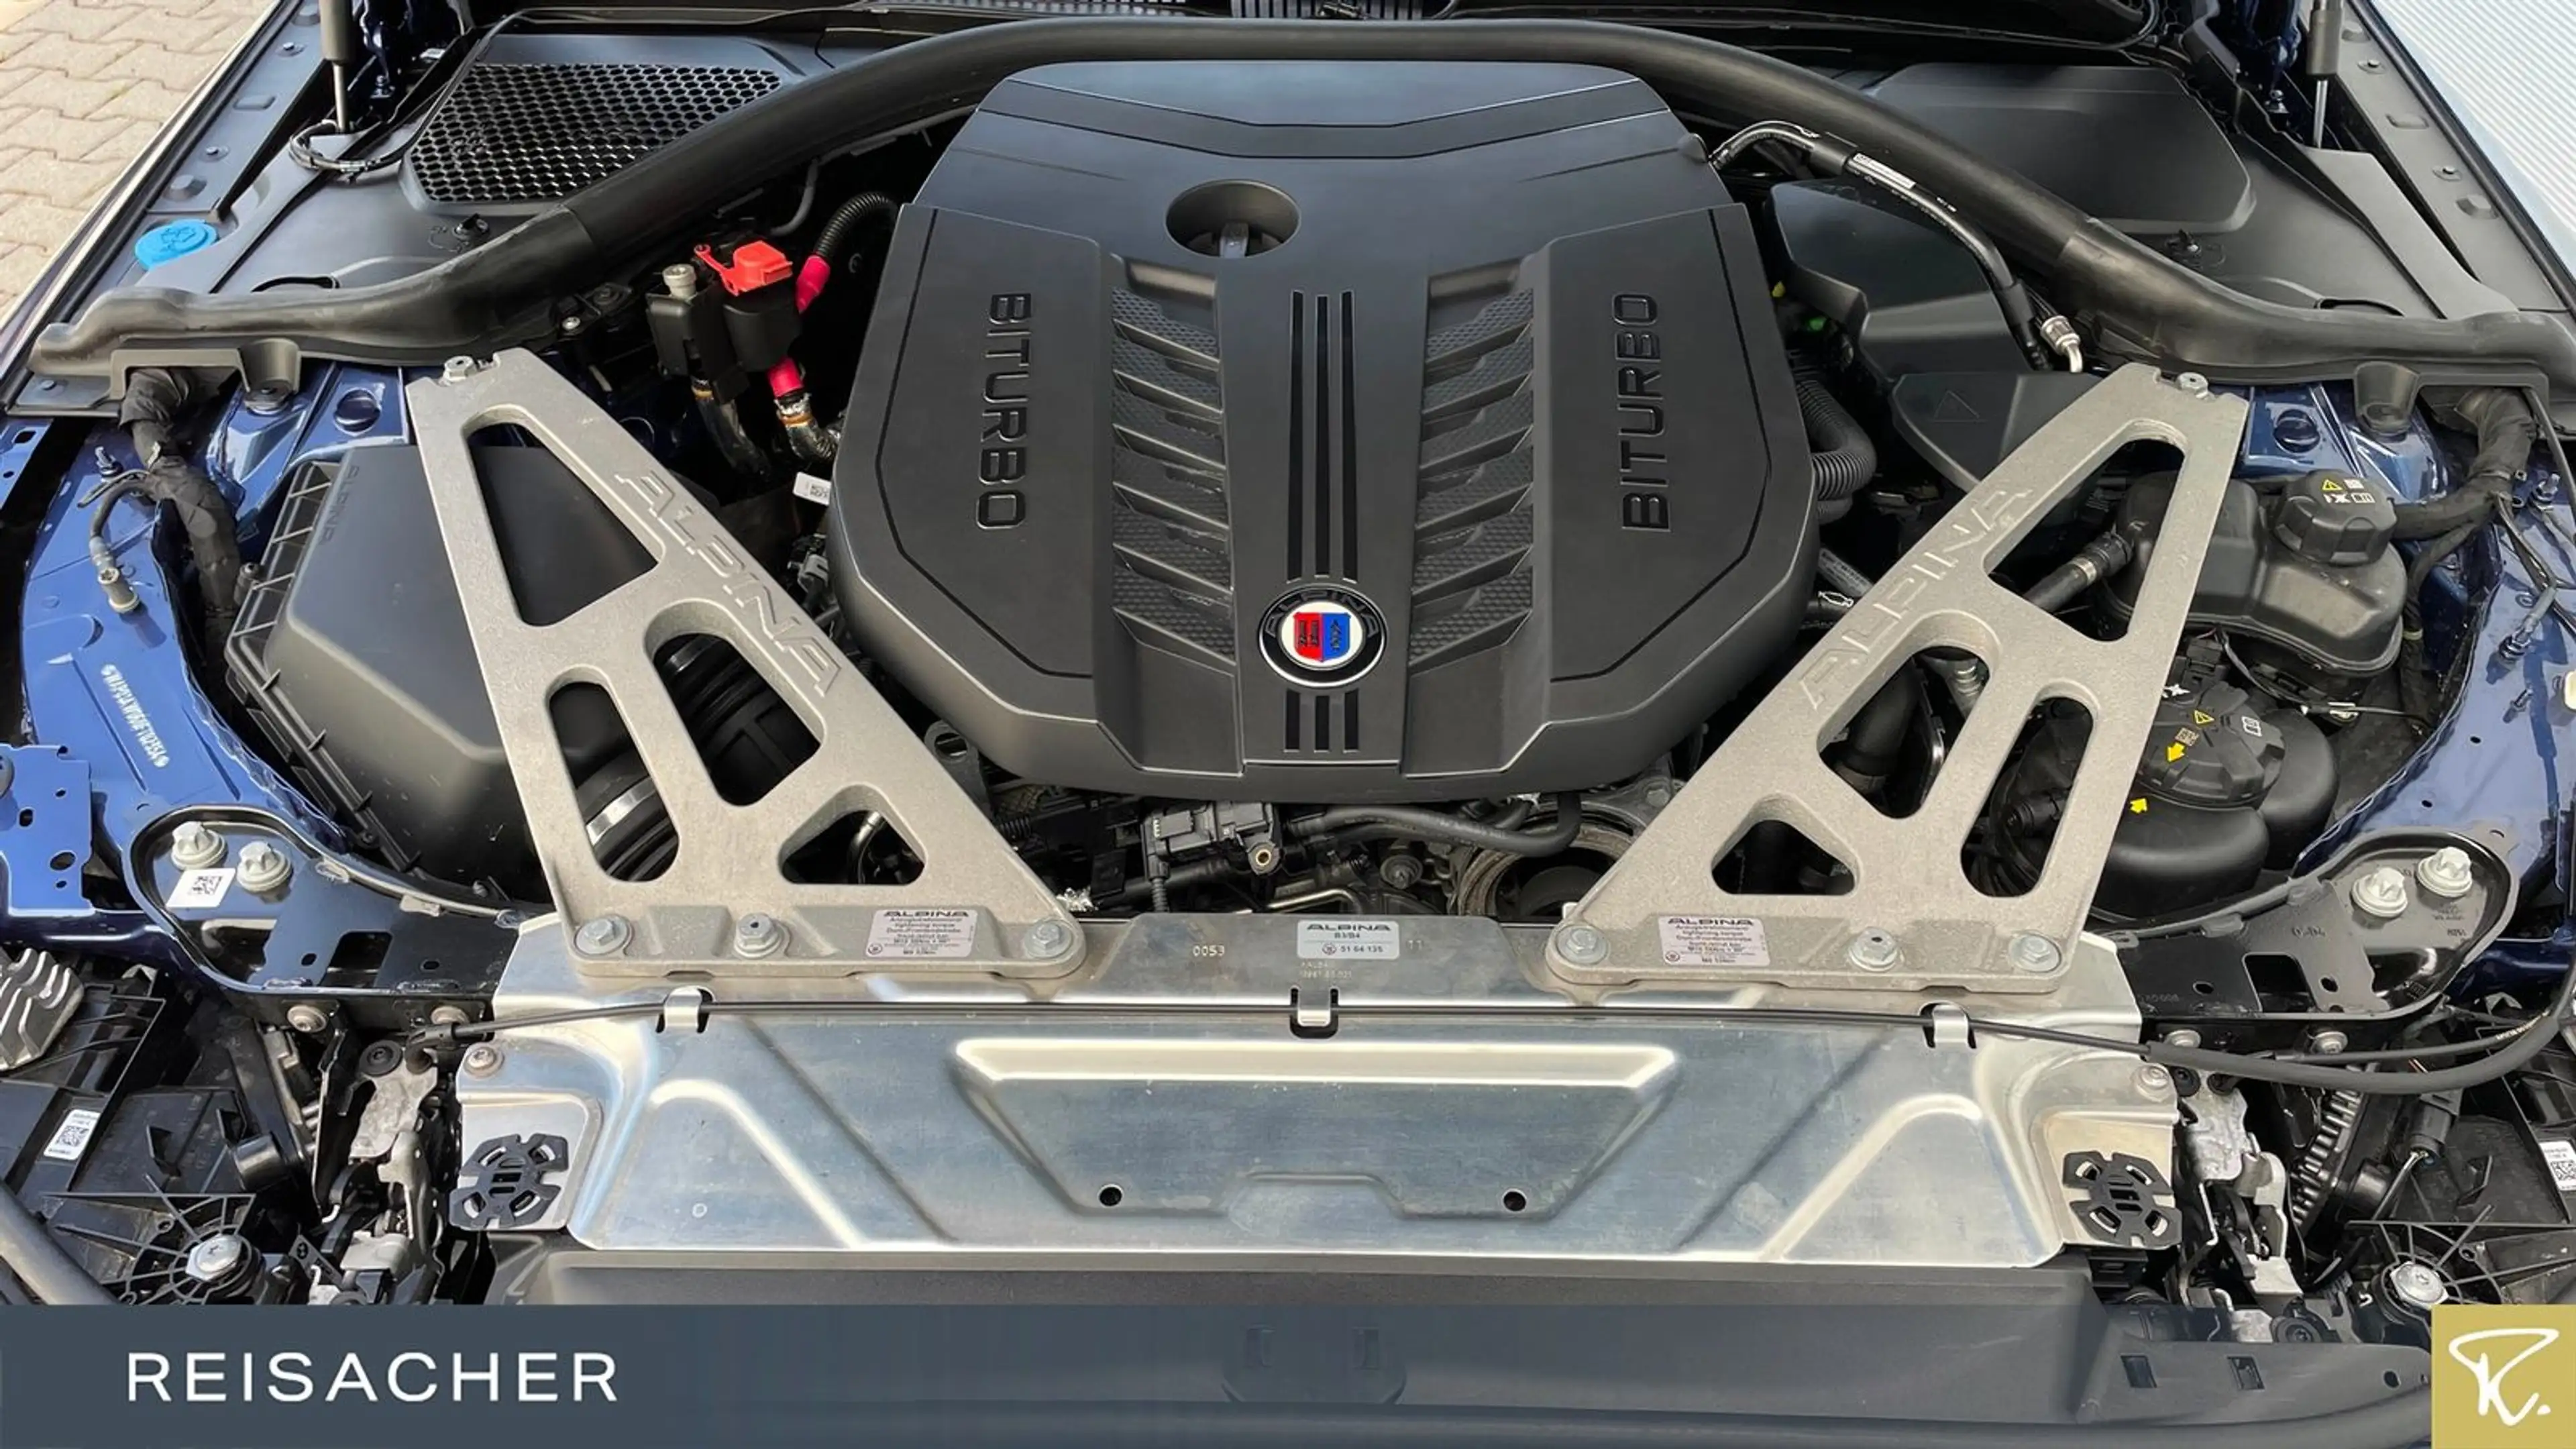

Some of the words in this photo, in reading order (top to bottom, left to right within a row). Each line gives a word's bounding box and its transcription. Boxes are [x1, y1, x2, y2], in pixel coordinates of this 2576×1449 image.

[976, 293, 1032, 529] BITURBO
[1613, 294, 1670, 533] BITURBO
[613, 470, 843, 698] ALPINA
[1265, 590, 1380, 638] ALPINA
[1800, 488, 2034, 710] ALPINA
[1668, 918, 1754, 926] ALPINA
